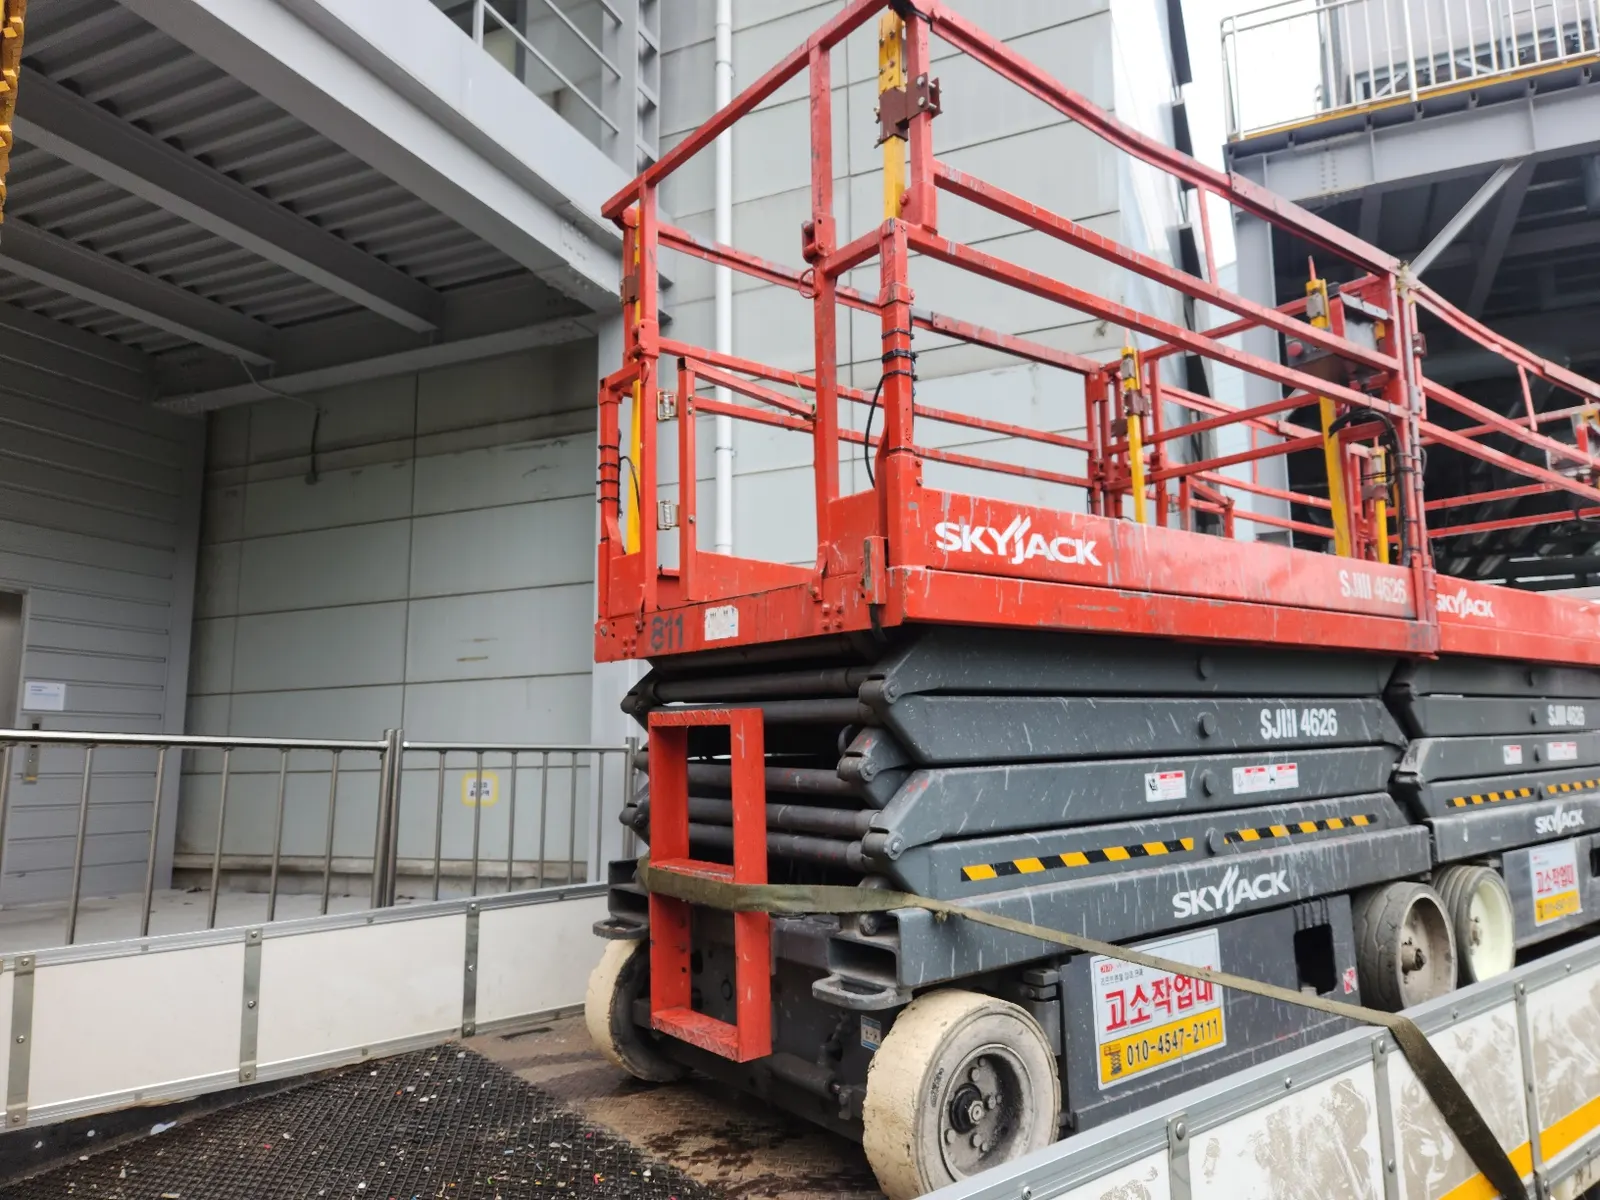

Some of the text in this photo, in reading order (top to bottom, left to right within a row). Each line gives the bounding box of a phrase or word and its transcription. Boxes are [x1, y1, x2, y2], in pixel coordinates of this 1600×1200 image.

[935, 514, 1102, 566] SKYJACK
[1374, 575, 1407, 604] 4626
[650, 612, 684, 652] 811
[1300, 707, 1338, 737] 4626
[1535, 804, 1585, 834] SKYJACK
[1172, 864, 1290, 918] SKYJACK
[1126, 1017, 1219, 1067] 010-4547-2111
